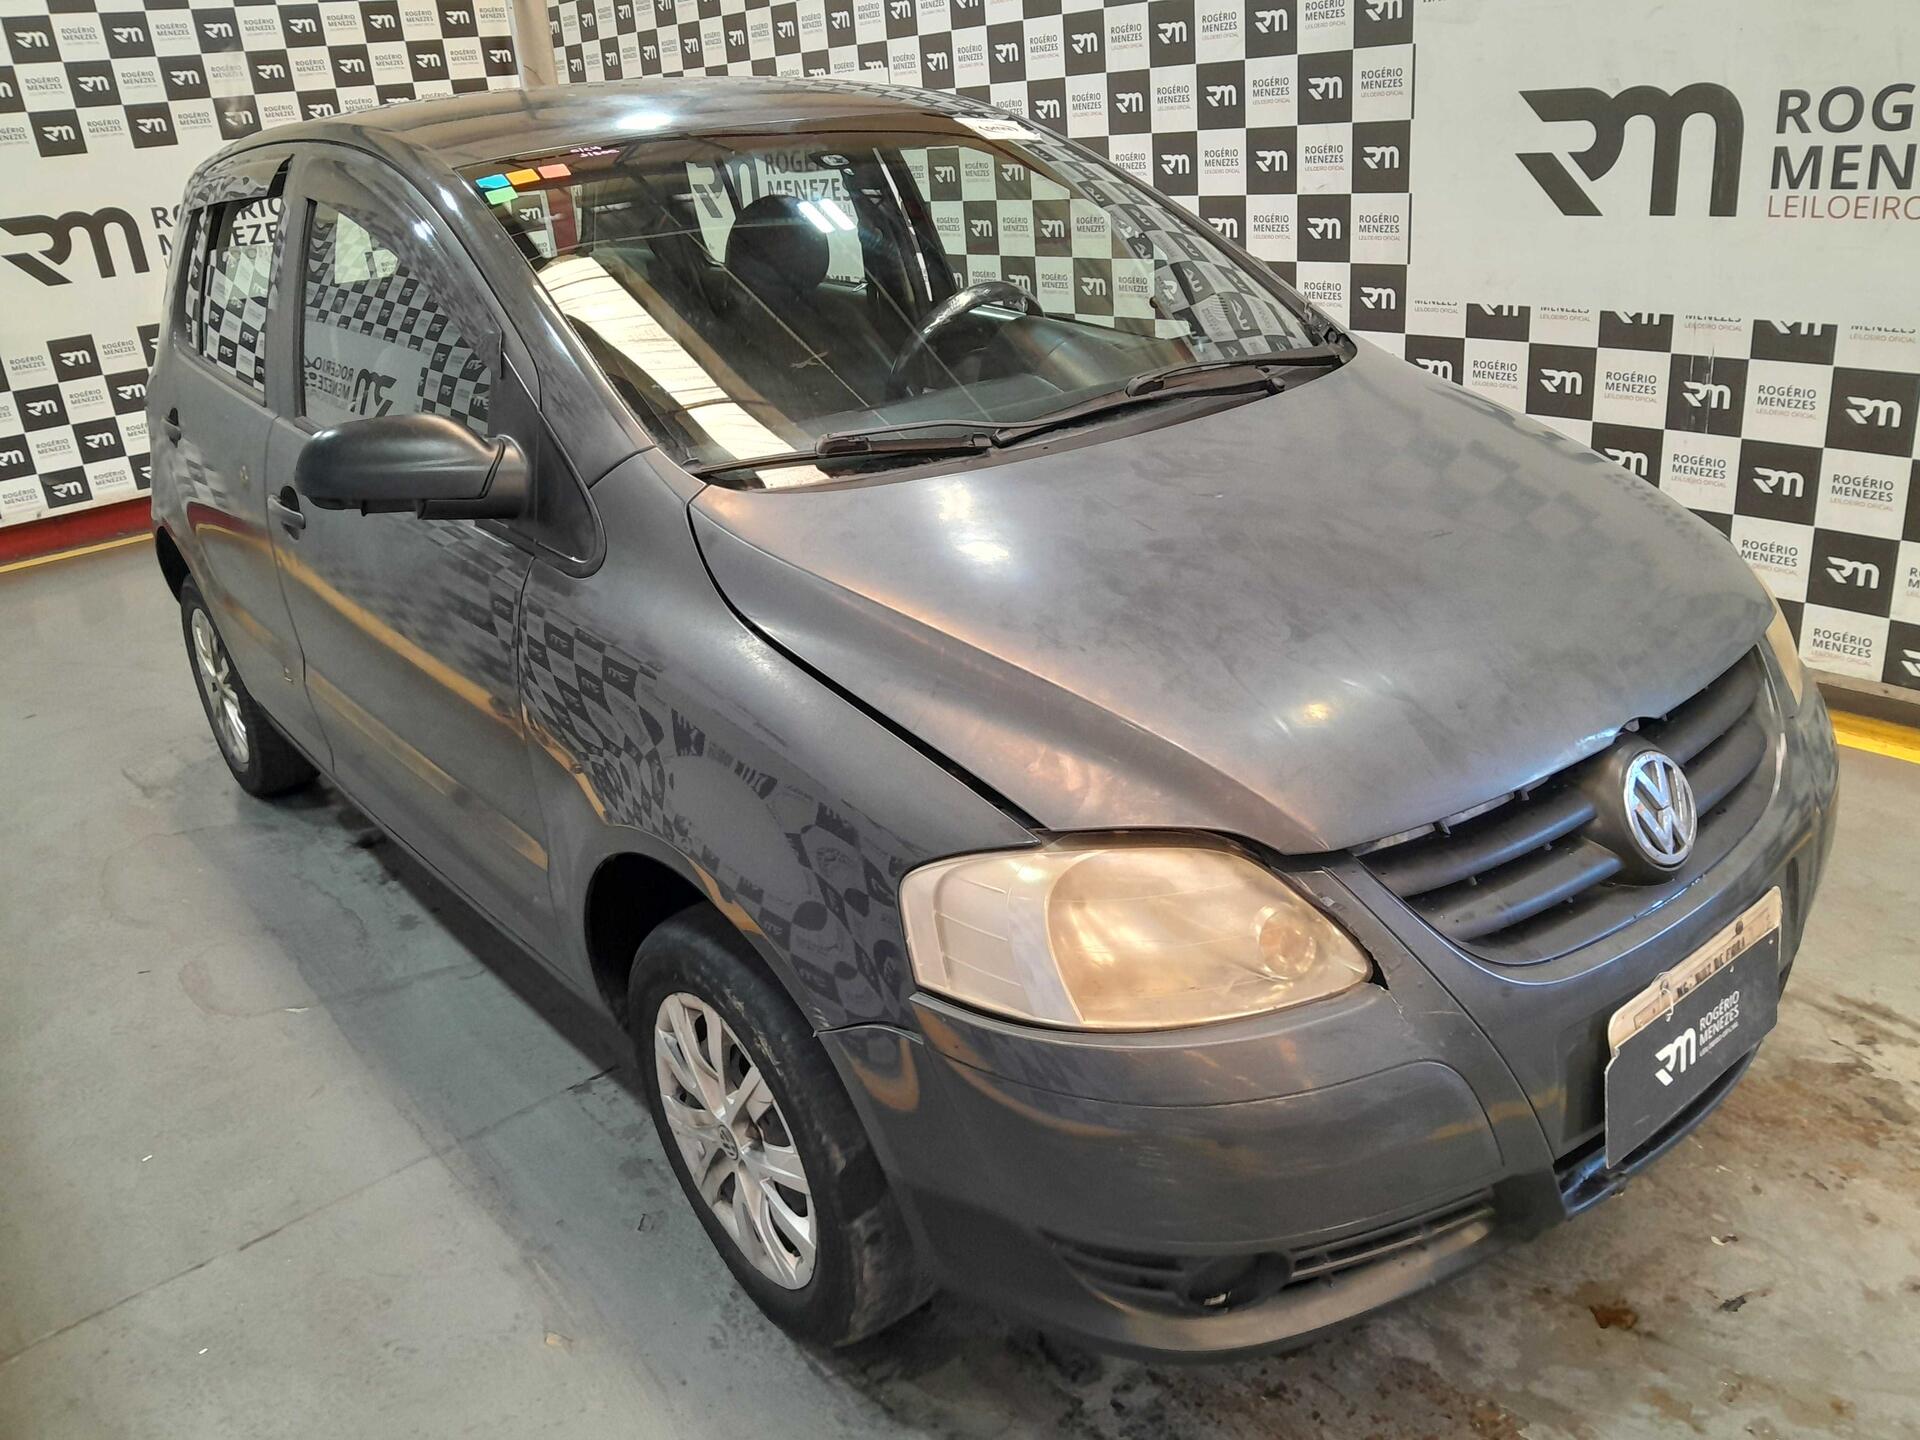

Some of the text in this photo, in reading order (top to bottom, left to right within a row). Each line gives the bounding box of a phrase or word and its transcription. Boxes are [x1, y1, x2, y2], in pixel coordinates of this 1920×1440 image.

[858, 2, 879, 12] ROGÉRIO
[1305, 0, 1345, 11] ROGÉRIO
[858, 10, 880, 20] MENEZES
[1202, 11, 1237, 23] ROGÉRIO
[1305, 8, 1345, 21] MENEZES
[1111, 23, 1141, 34] ROGÉRIO
[1202, 21, 1237, 32] MENEZES
[1030, 34, 1057, 45] ROGÉRIO
[1111, 32, 1143, 43] MENEZES
[957, 44, 982, 54] ROGÉRIO
[1030, 43, 1058, 53] MENEZES
[893, 53, 915, 62] ROGÉRIO
[958, 53, 983, 62] MENEZES
[893, 61, 916, 70] MENEZES
[1361, 67, 1403, 79] ROGÉRIO
[1253, 76, 1289, 88] ROGÉRIO
[1361, 78, 1403, 89] MENEZES
[1157, 84, 1189, 95] ROGÉRIO
[1253, 87, 1289, 97] MENEZES
[1072, 93, 1101, 102] ROGÉRIO
[1157, 94, 1190, 104] MENEZES
[1072, 101, 1102, 110] MENEZES
[265, 110, 295, 118] MENEZES
[87, 119, 120, 127] ROGÉRIO
[89, 125, 122, 133] MENEZES
[1204, 148, 1238, 158] ROGÉRIO
[1305, 144, 1343, 154] ROGÉRIO
[1116, 152, 1145, 161] ROGÉRIO
[1305, 154, 1343, 164] MENEZES
[1205, 158, 1239, 167] MENEZES
[1770, 144, 1917, 190] MEN
[1253, 214, 1289, 223] ROGÉRIO
[1359, 213, 1399, 223] ROGÉRIO
[1254, 224, 1289, 232] MENEZES
[1359, 224, 1399, 233] MENEZES
[1304, 281, 1341, 291] ROGÉRIO
[1304, 291, 1342, 300] MENEZES
[9, 355, 43, 365] ROGÉRIO
[11, 361, 45, 371] MENEZES
[1473, 360, 1517, 372] ROGÉRIO
[1473, 370, 1517, 382] MENEZES
[1606, 371, 1657, 384] ROGÉRIO
[1605, 382, 1656, 395] MENEZES
[1758, 385, 1816, 399] ROGÉRIO
[69, 389, 101, 399] ROGÉRIO
[71, 395, 103, 405] MENEZES
[1757, 396, 1816, 410] MENEZES
[1673, 454, 1726, 468] ROGÉRIO
[94, 470, 125, 480] ROGÉRIO
[1672, 464, 1726, 479] MENEZES
[95, 475, 127, 486] MENEZES
[1833, 474, 1894, 491] ROGÉRIO
[2, 488, 36, 499] ROGÉRIO
[1831, 485, 1893, 502] MENEZES
[4, 494, 38, 504] MENEZES
[1742, 539, 1798, 556] ROGÉRIO
[1740, 550, 1797, 567] MENEZES
[1814, 628, 1872, 647] ROGÉRIO
[1812, 638, 1871, 658] MENEZES
[1700, 991, 1740, 1031] ROGÉRIO
[1700, 1005, 1739, 1046] MENEZES
